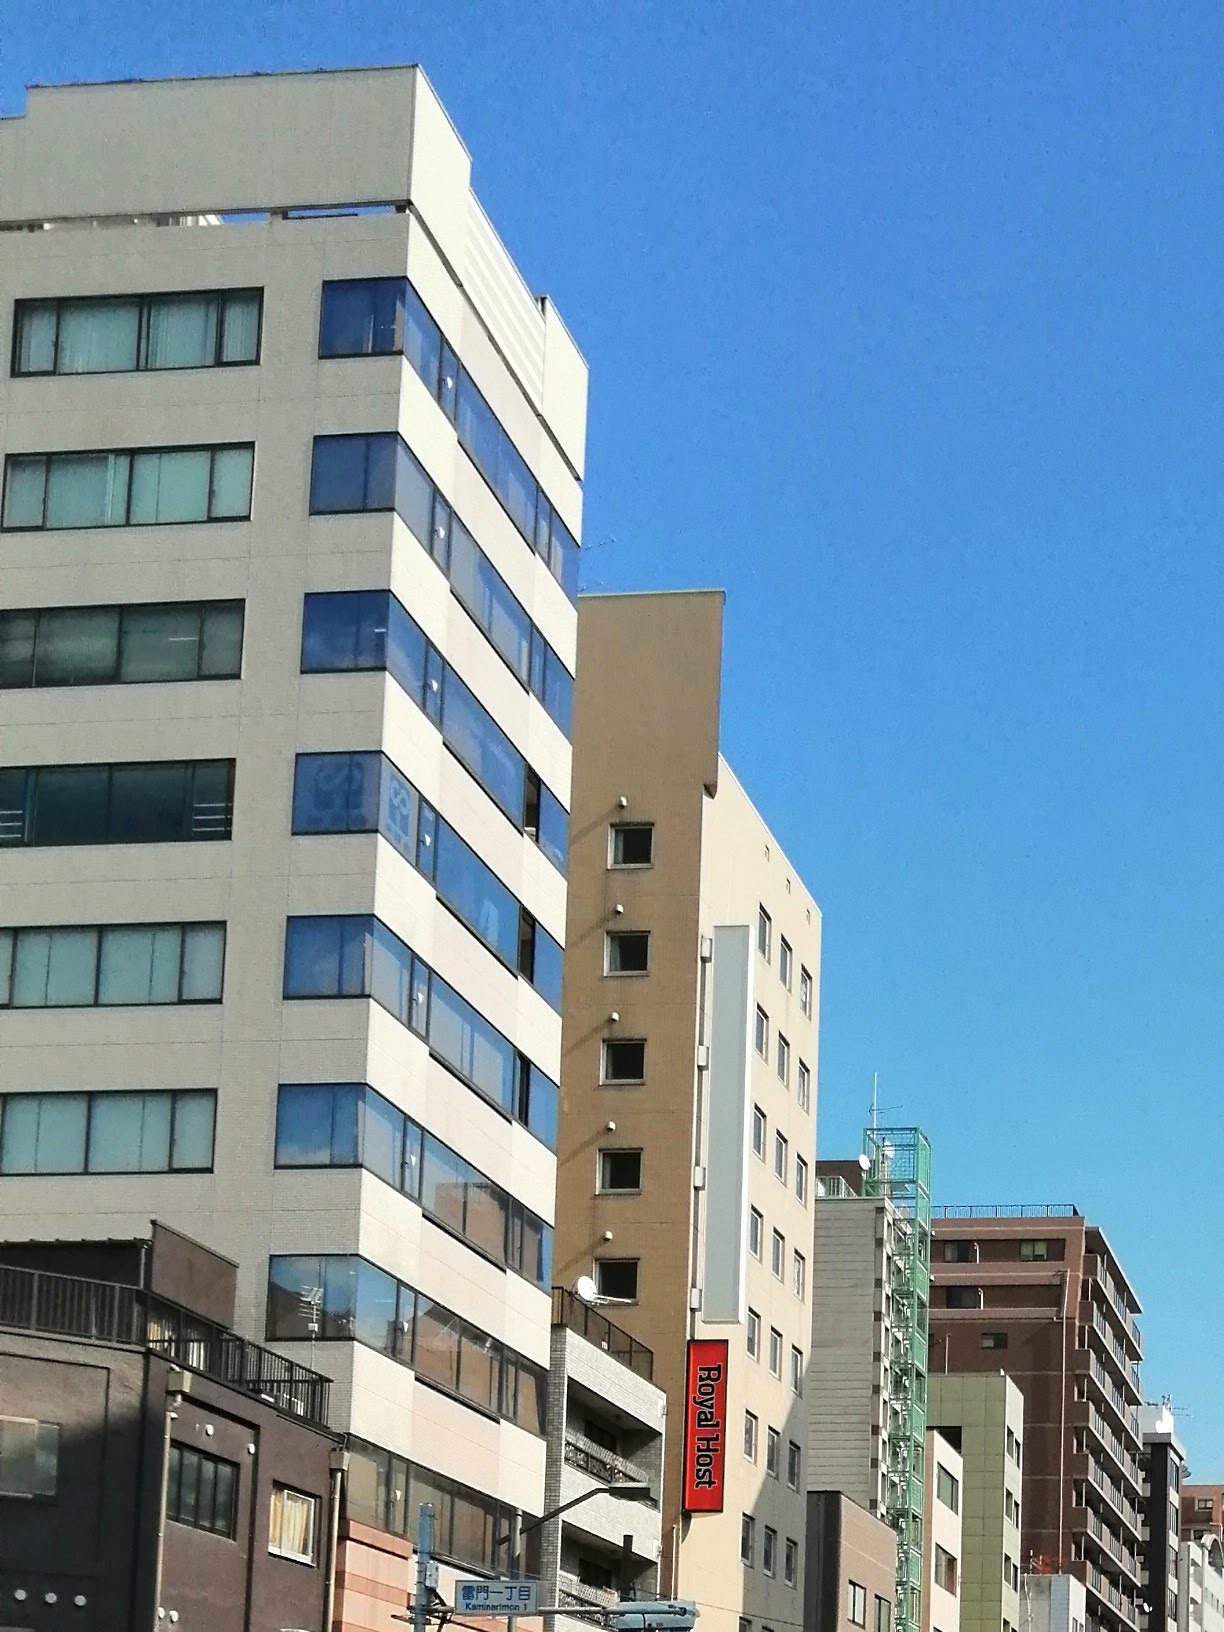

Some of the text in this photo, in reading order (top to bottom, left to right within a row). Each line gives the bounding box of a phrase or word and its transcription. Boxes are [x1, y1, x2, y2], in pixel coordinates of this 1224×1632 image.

[693, 1363, 722, 1489] Royal Host
[461, 1585, 531, 1601] 雷門一丁目
[465, 1602, 527, 1611] Kaminarimon 1
